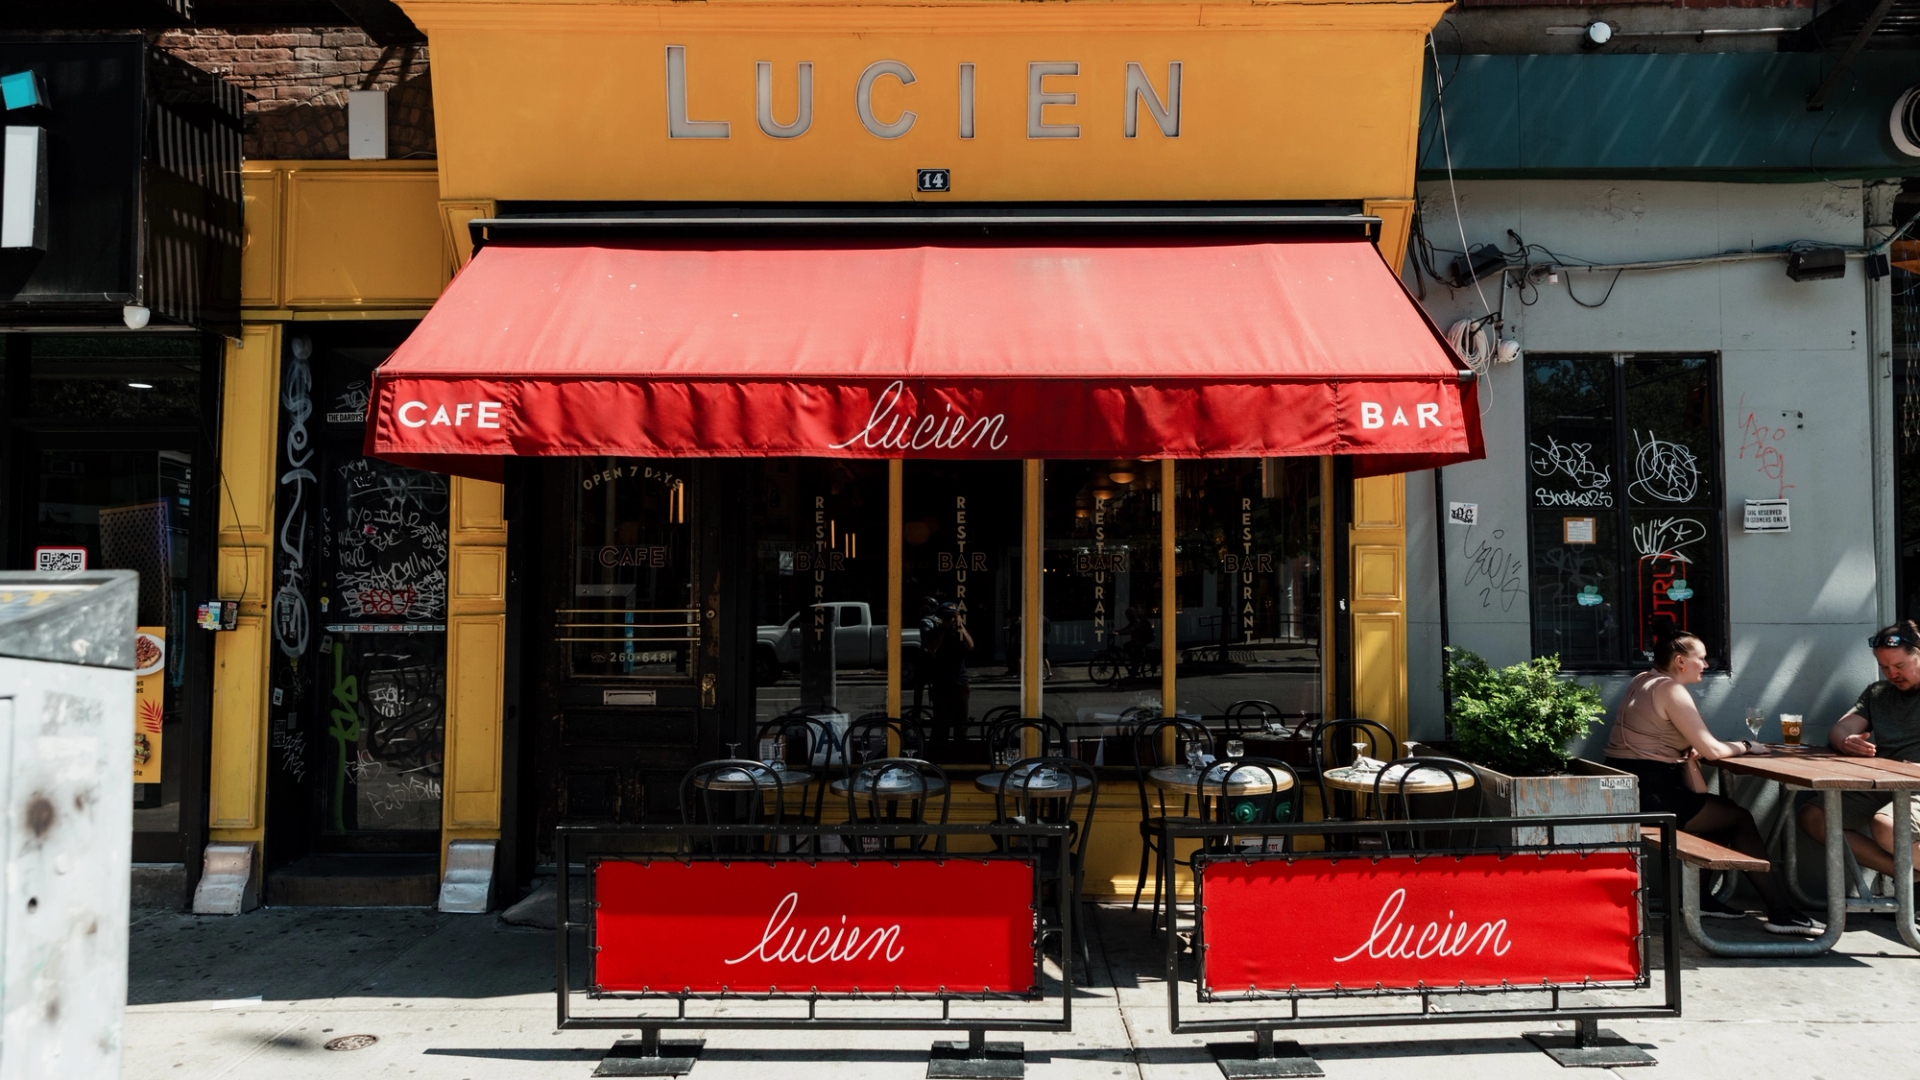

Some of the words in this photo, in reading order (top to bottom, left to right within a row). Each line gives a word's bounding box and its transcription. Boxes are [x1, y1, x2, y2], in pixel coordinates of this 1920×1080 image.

[665, 45, 1184, 139] LUCIEN
[922, 172, 944, 188] 14
[327, 414, 340, 422] THE
[397, 400, 502, 429] CAFE
[828, 380, 1008, 451] lucien
[1360, 401, 1444, 429] BAR
[582, 466, 624, 491] OPEN
[629, 466, 640, 478] 7
[644, 466, 684, 492] DAYS
[598, 545, 666, 568] CAFE
[796, 552, 846, 572] BAR
[937, 552, 988, 572] BAR
[1076, 554, 1126, 573] BAR
[1094, 497, 1105, 643] RESTAURANT
[1224, 554, 1273, 573] BAR
[1241, 497, 1254, 645] RESTAURANT
[815, 721, 842, 753] A
[724, 891, 905, 965] lucien
[1333, 888, 1512, 963] lucien
